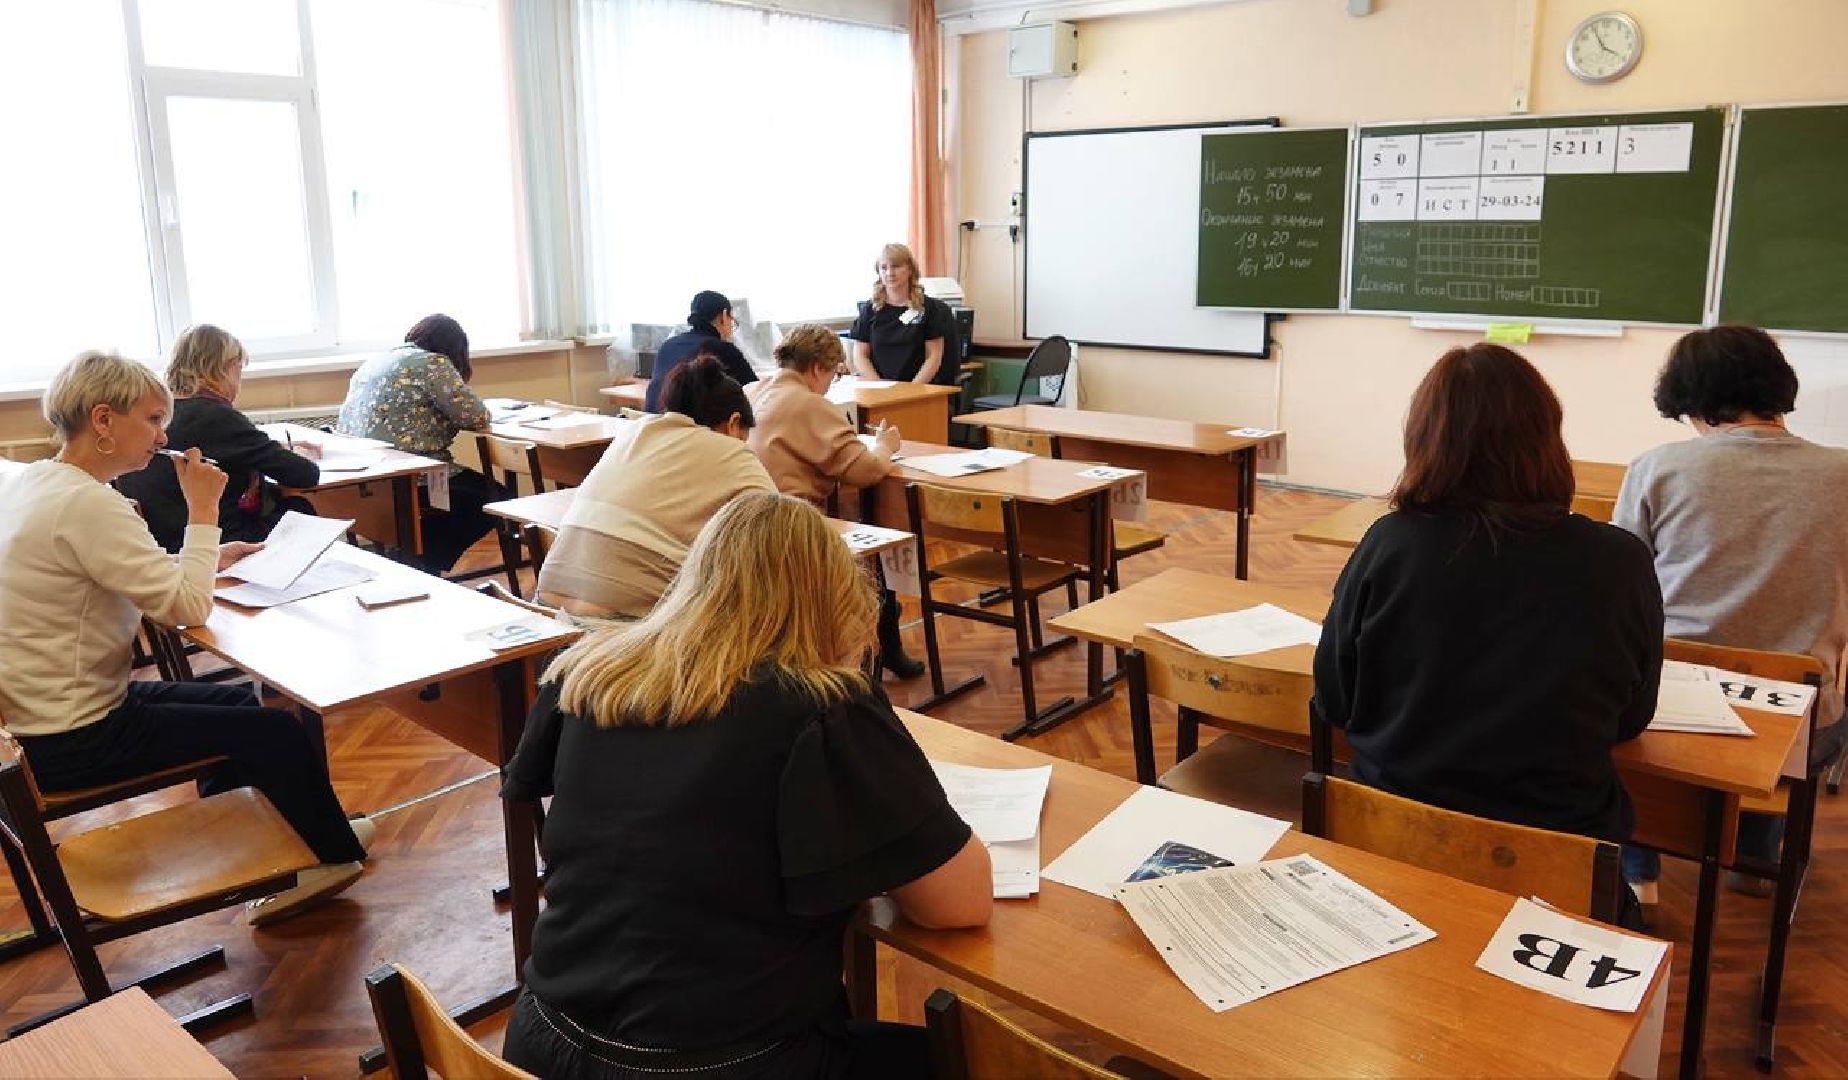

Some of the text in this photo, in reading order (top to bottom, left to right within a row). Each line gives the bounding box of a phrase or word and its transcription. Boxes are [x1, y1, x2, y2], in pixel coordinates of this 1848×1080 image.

[1624, 137, 1634, 155] 3
[1373, 153, 1406, 166] 5 0
[1265, 184, 1287, 202] 50
[1371, 193, 1404, 206] 0 7
[1480, 195, 1541, 207] 29-03-24
[1270, 231, 1290, 247] 20
